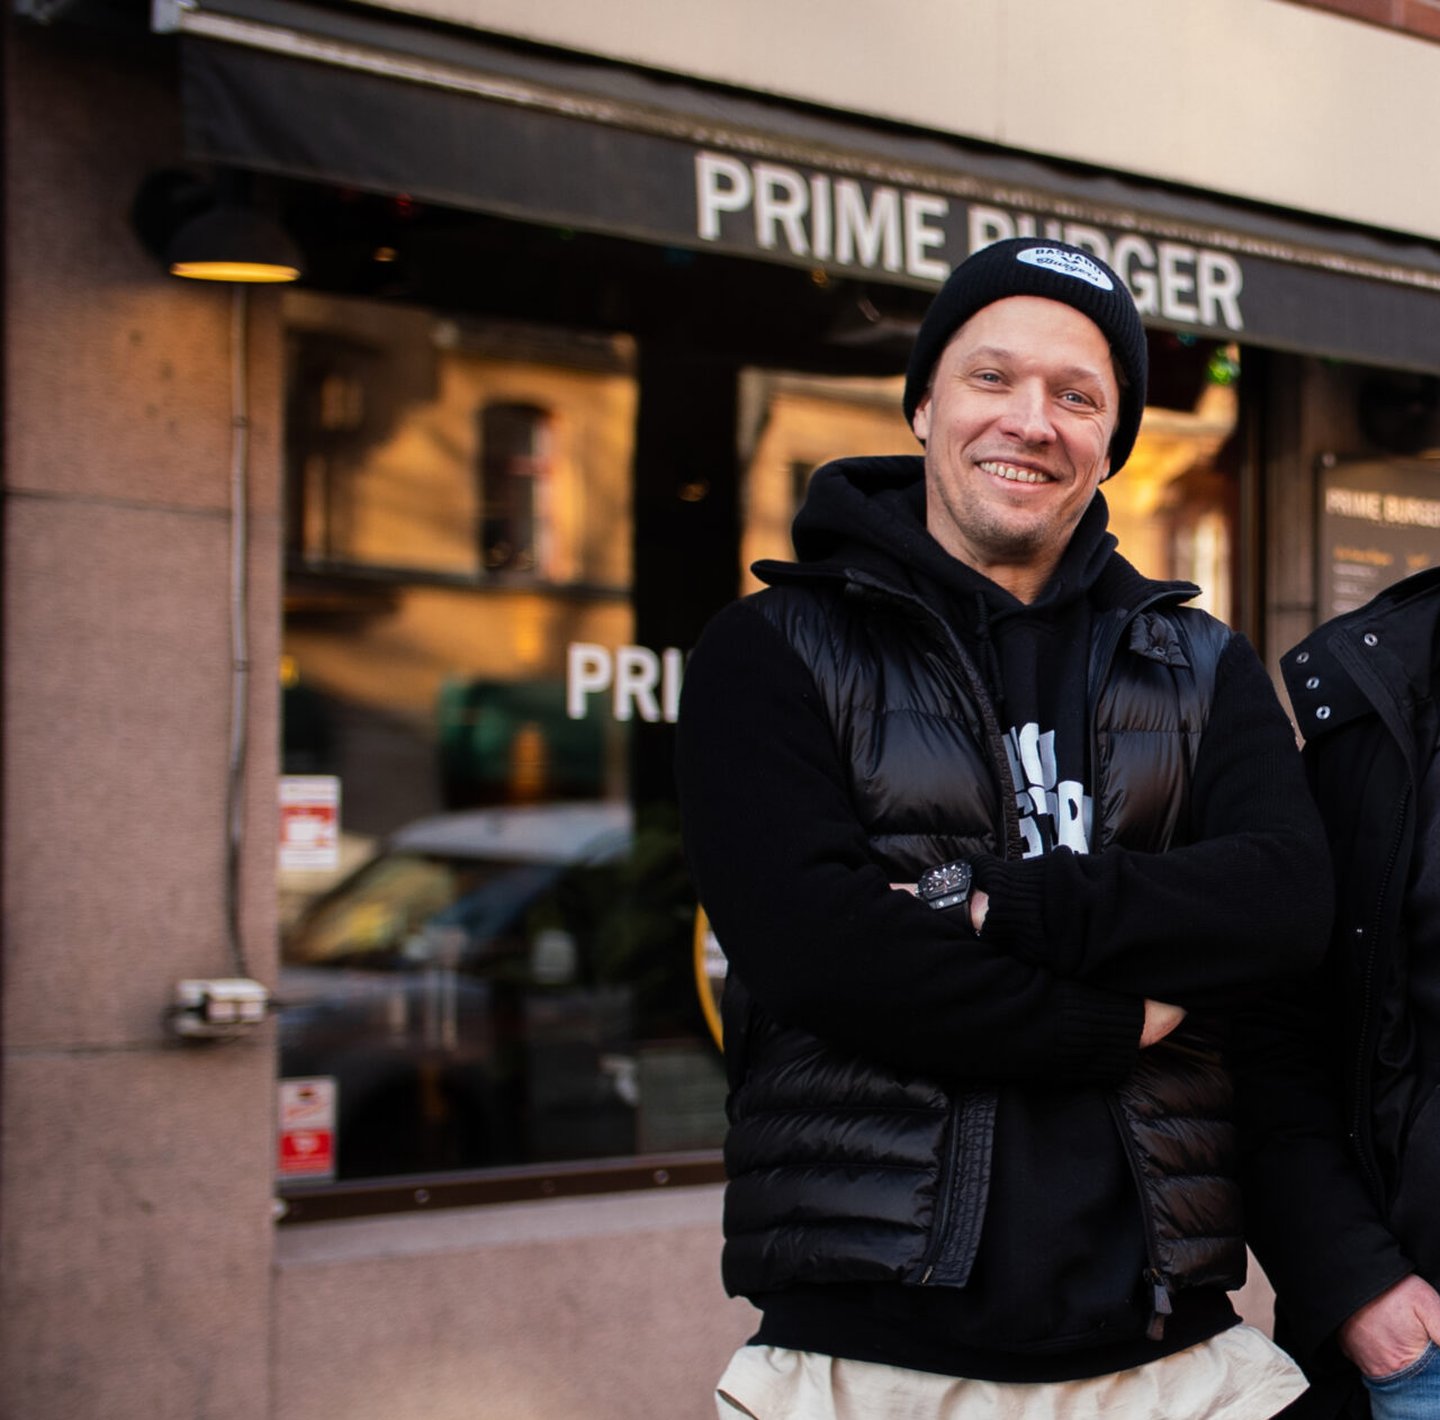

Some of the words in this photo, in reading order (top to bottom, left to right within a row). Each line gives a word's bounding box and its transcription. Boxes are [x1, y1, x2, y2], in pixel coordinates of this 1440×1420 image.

[694, 152, 951, 281] PRIME
[968, 205, 1244, 330] BGER
[567, 641, 680, 724] PRI
